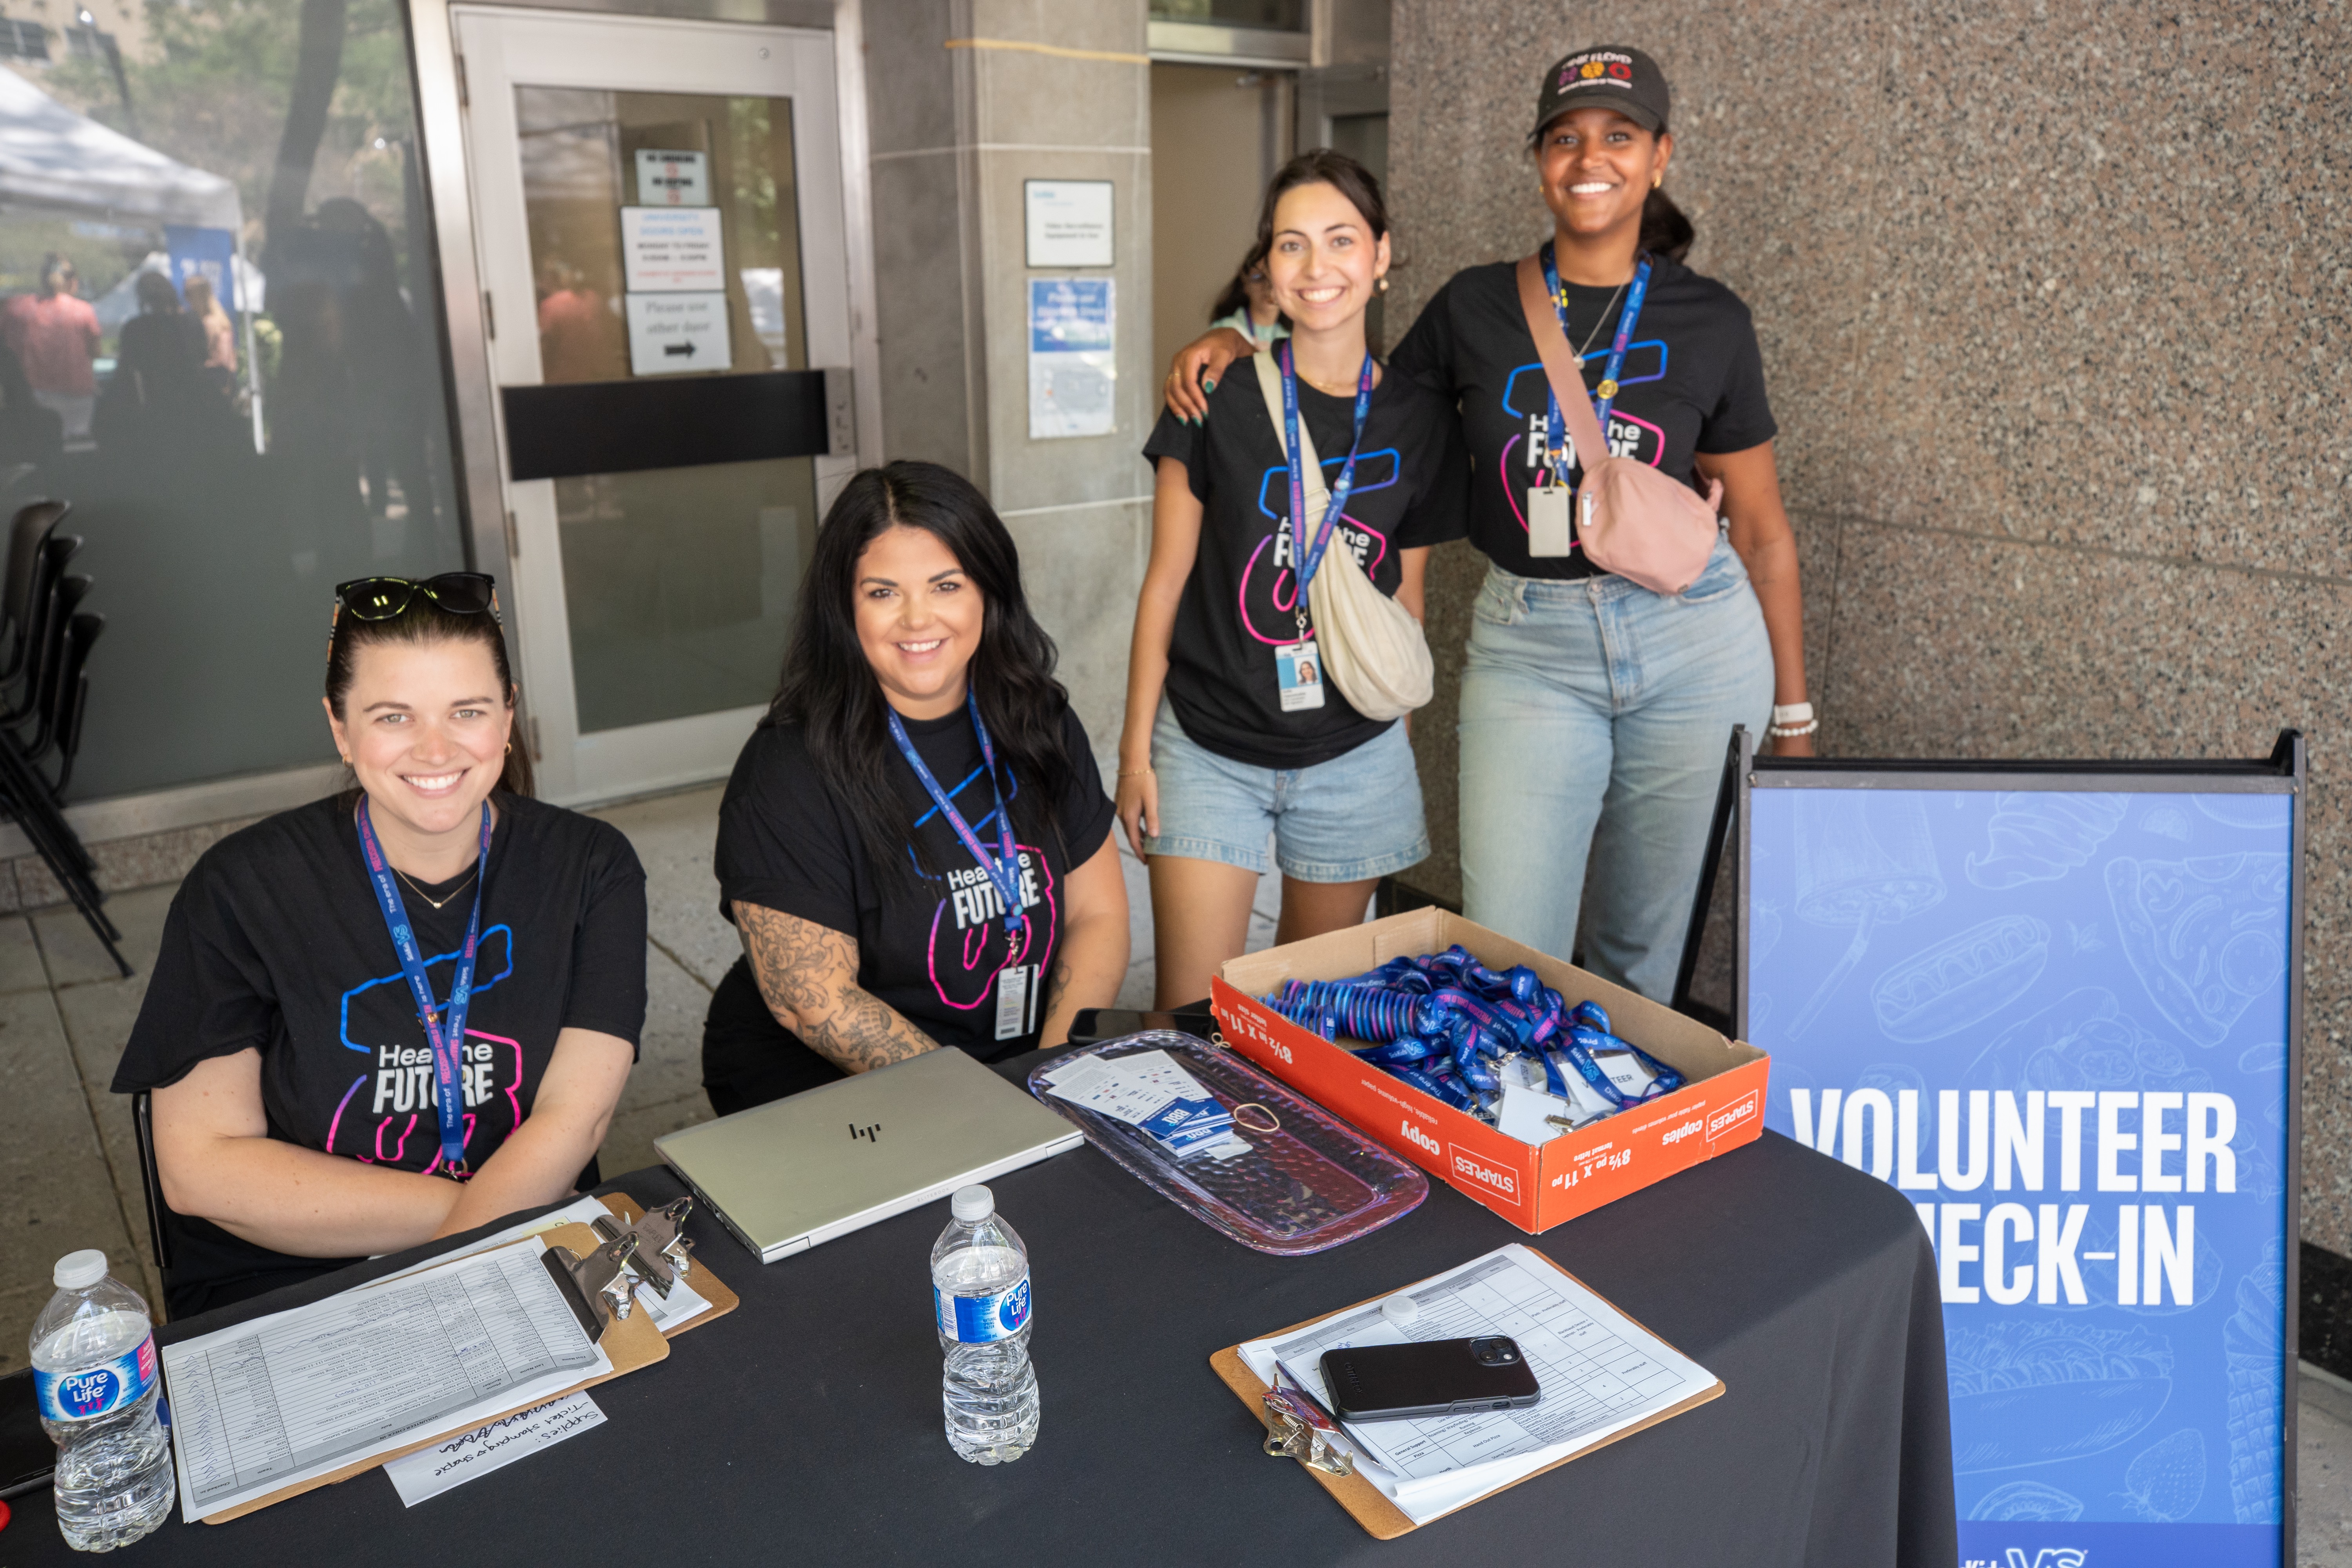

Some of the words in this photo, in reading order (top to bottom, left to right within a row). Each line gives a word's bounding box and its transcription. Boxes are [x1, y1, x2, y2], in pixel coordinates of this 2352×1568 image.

[1590, 52, 1632, 64] FLOYD
[972, 844, 993, 870] PRECISION
[947, 865, 989, 890] Hea
[994, 853, 1031, 874] te
[377, 873, 386, 884] of
[381, 882, 391, 898] era
[386, 897, 397, 913] The
[413, 974, 425, 995] here
[452, 1014, 462, 1037] Treat
[1230, 1014, 1245, 1034] 11
[1250, 1012, 1267, 1027] letter
[379, 1045, 433, 1067] Hea
[435, 1048, 452, 1085] PRECISION
[1361, 1080, 1376, 1091] paper
[1418, 1076, 1430, 1086] era
[443, 1087, 451, 1098] of
[1430, 1084, 1442, 1097] The
[444, 1097, 454, 1113] era
[1377, 1088, 1413, 1113] high-volume
[1691, 1100, 1706, 1110] papier
[1161, 1108, 1192, 1123] BBQ
[1414, 1107, 1437, 1125] reliable,
[1667, 1111, 1678, 1120] pour
[1678, 1107, 1690, 1115] fiable
[1710, 1100, 1754, 1134] STAPLES
[444, 1112, 455, 1129] The
[1648, 1116, 1666, 1127] volumes
[1632, 1124, 1647, 1134] élevés
[1662, 1119, 1703, 1145] copies
[1401, 1120, 1440, 1155] copy
[1790, 1089, 2237, 1192] VOLUNTEER
[1592, 1142, 1612, 1155] format
[1573, 1150, 1591, 1161] lettre
[1596, 1156, 1607, 1169] po
[1455, 1146, 1514, 1203] STAPLES
[1552, 1174, 1563, 1187] po
[1564, 1170, 1579, 1189] 11
[917, 1187, 949, 1202] ELITEBOOK
[1915, 1203, 2194, 1305] ECK-IN
[1454, 1277, 1473, 1286] Volunteers
[1007, 1283, 1027, 1306] Pure
[1011, 1298, 1026, 1316] Life
[1541, 1303, 1559, 1312] Preferably
[1413, 1321, 1434, 1330] Vasconcelos
[1557, 1325, 1575, 1334] Blackbaud
[1576, 1322, 1594, 1331] Preferably
[1413, 1333, 1432, 1342] Evangeline
[561, 1355, 575, 1363] Name
[1621, 1365, 1639, 1374] Preferably
[66, 1372, 108, 1391] Pure
[483, 1378, 501, 1387] Number
[1344, 1363, 1363, 1395] OTTERBOX
[73, 1387, 105, 1403] Life
[357, 1401, 380, 1411] Starbucks
[406, 1415, 438, 1429] VOLUNTEER
[1554, 1410, 1576, 1421] 11am-12pm
[244, 1424, 265, 1432] Services
[254, 1424, 282, 1435] President's
[341, 1417, 385, 1434] Vegetarian/Vegan
[530, 1411, 598, 1443] Supplies:
[1428, 1428, 1446, 1437] Roaming/
[1445, 1418, 1468, 1429] Wayfinding/
[1463, 1426, 1482, 1435] Replenish
[1523, 1419, 1542, 1429] Samantha
[379, 1428, 405, 1440] CHECK-IN
[1395, 1446, 1411, 1455] General
[1410, 1440, 1426, 1448] Support
[269, 1451, 289, 1461] External
[207, 1482, 230, 1492] Checked
